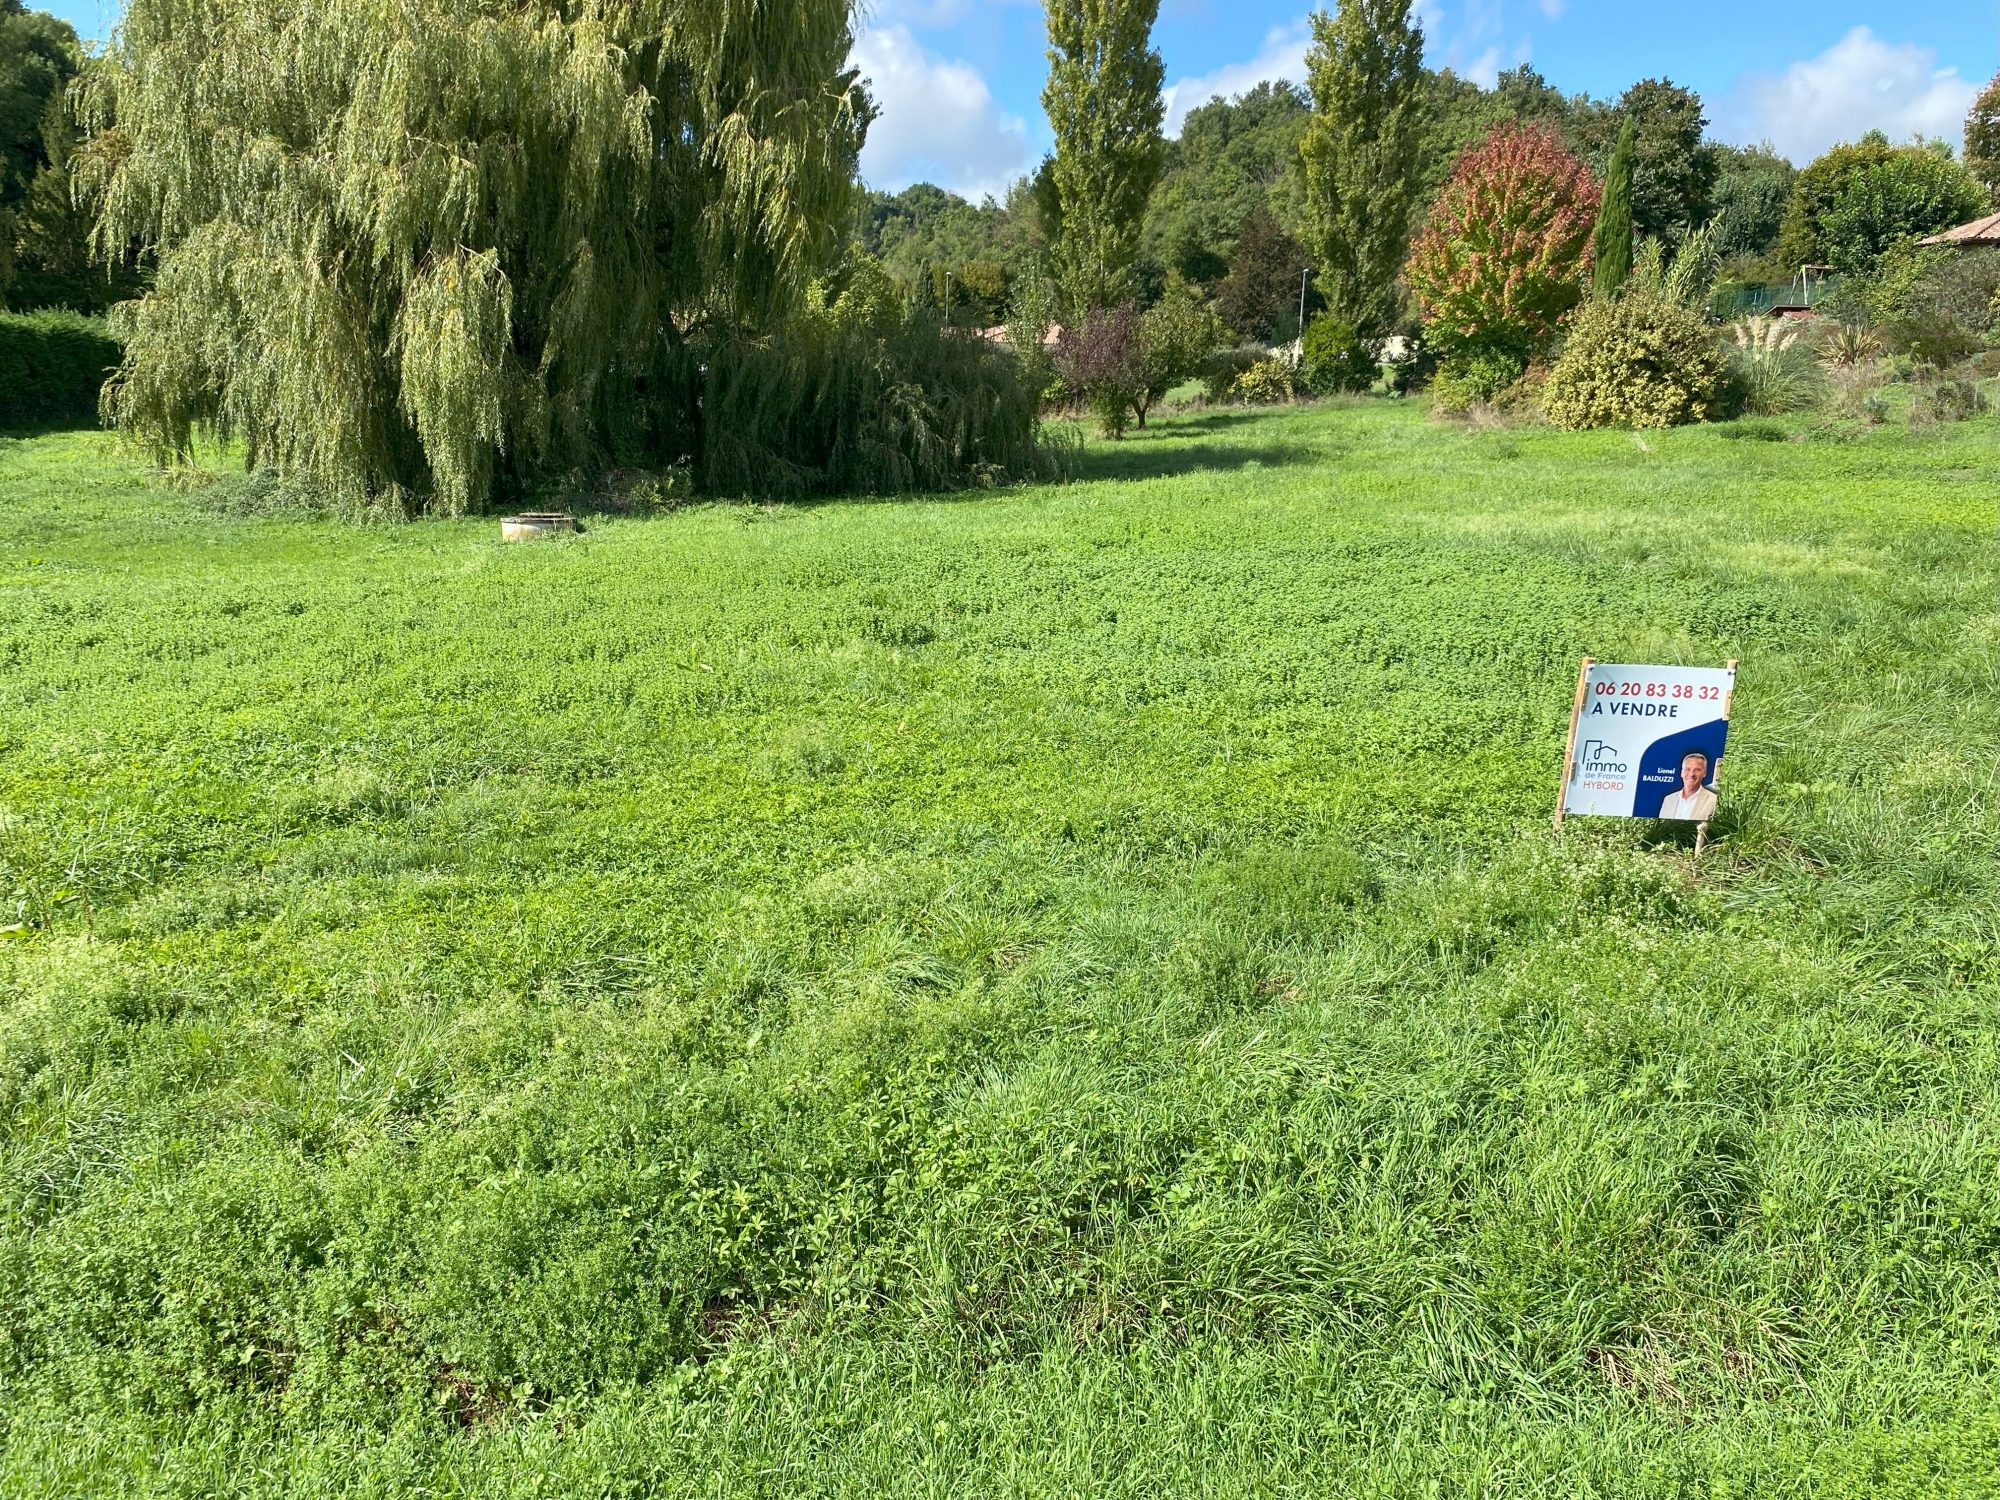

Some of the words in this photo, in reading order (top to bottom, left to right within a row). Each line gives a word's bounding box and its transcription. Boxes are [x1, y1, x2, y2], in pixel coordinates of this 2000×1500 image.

[1595, 681, 1616, 696] 06
[1620, 682, 1641, 696] 20
[1645, 683, 1667, 697] 83
[1672, 684, 1693, 699] 38
[1698, 686, 1720, 700] 32
[1591, 702, 1603, 715] A
[1609, 702, 1678, 718] VENDRE
[1585, 758, 1628, 773] immo
[1584, 772, 1596, 780] de
[1597, 772, 1626, 780] France
[1657, 767, 1676, 775] Lionel
[1642, 775, 1674, 783] BALDUZZI
[1583, 781, 1624, 791] HYBORD
